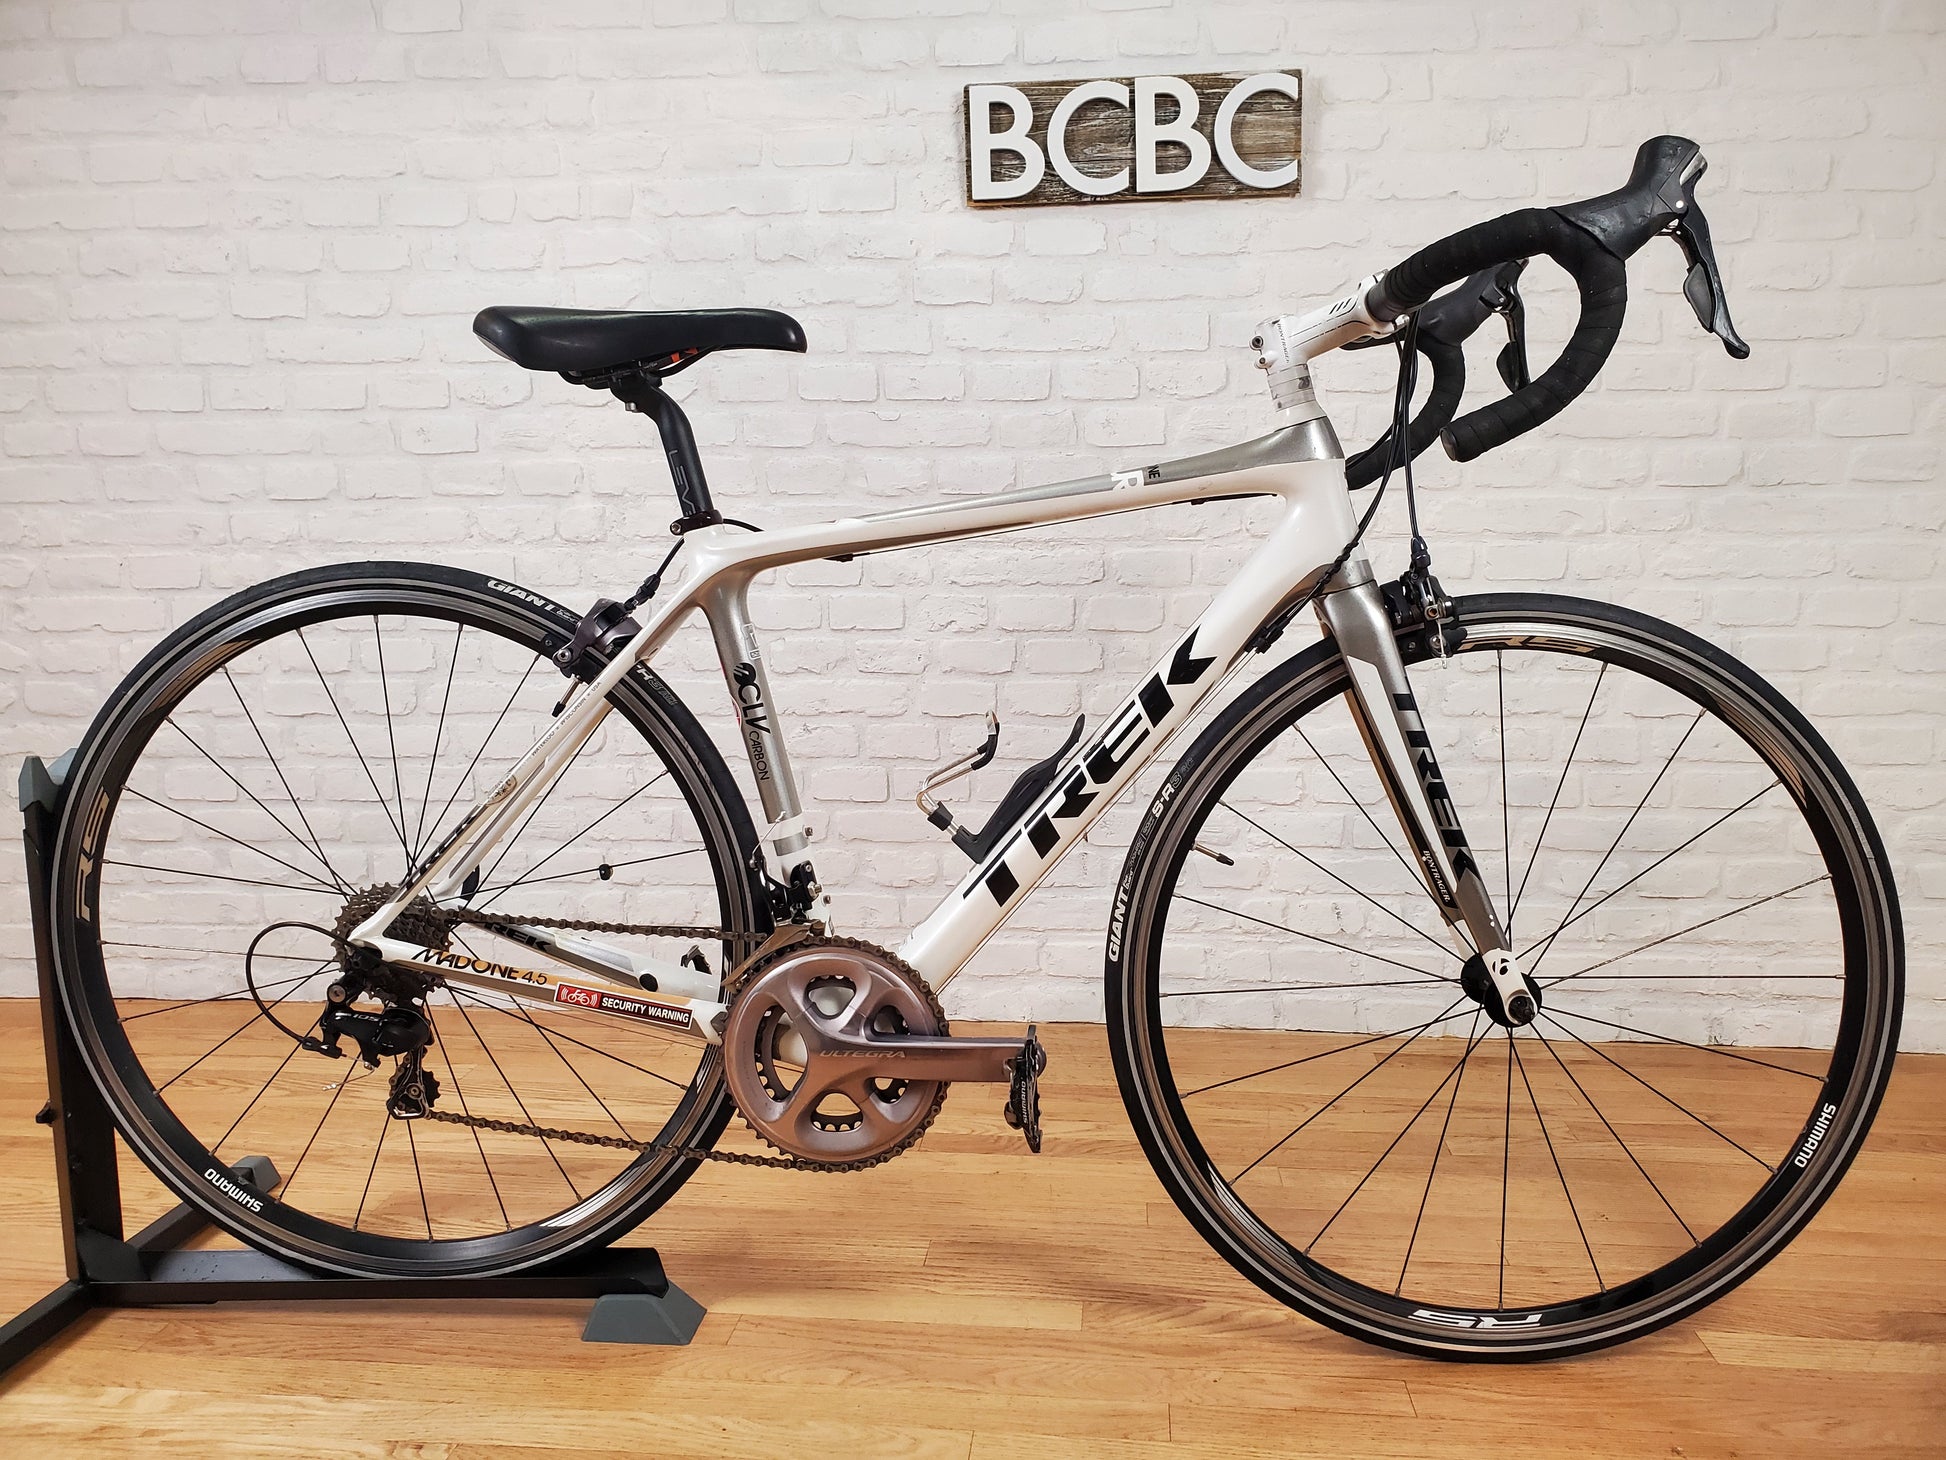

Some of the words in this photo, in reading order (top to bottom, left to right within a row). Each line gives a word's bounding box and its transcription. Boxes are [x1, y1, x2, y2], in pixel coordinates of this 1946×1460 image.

[969, 72, 1298, 200] BCBC
[487, 579, 556, 612] GIANT
[591, 681, 602, 692] USA
[749, 730, 770, 781] CARBON
[962, 623, 1218, 908] TREK
[1392, 693, 1482, 882] TREK
[1423, 849, 1450, 903] BONTRAGER
[1108, 887, 1131, 962] GIANT
[411, 948, 519, 981] MADONE
[521, 969, 548, 986] 4.5
[602, 996, 647, 1014] SECURITY
[648, 1005, 690, 1024] WARNING
[819, 1049, 906, 1059] ULTEGRA
[1794, 1102, 1837, 1168] SHIMANO
[204, 1168, 264, 1212] SHIMANO
